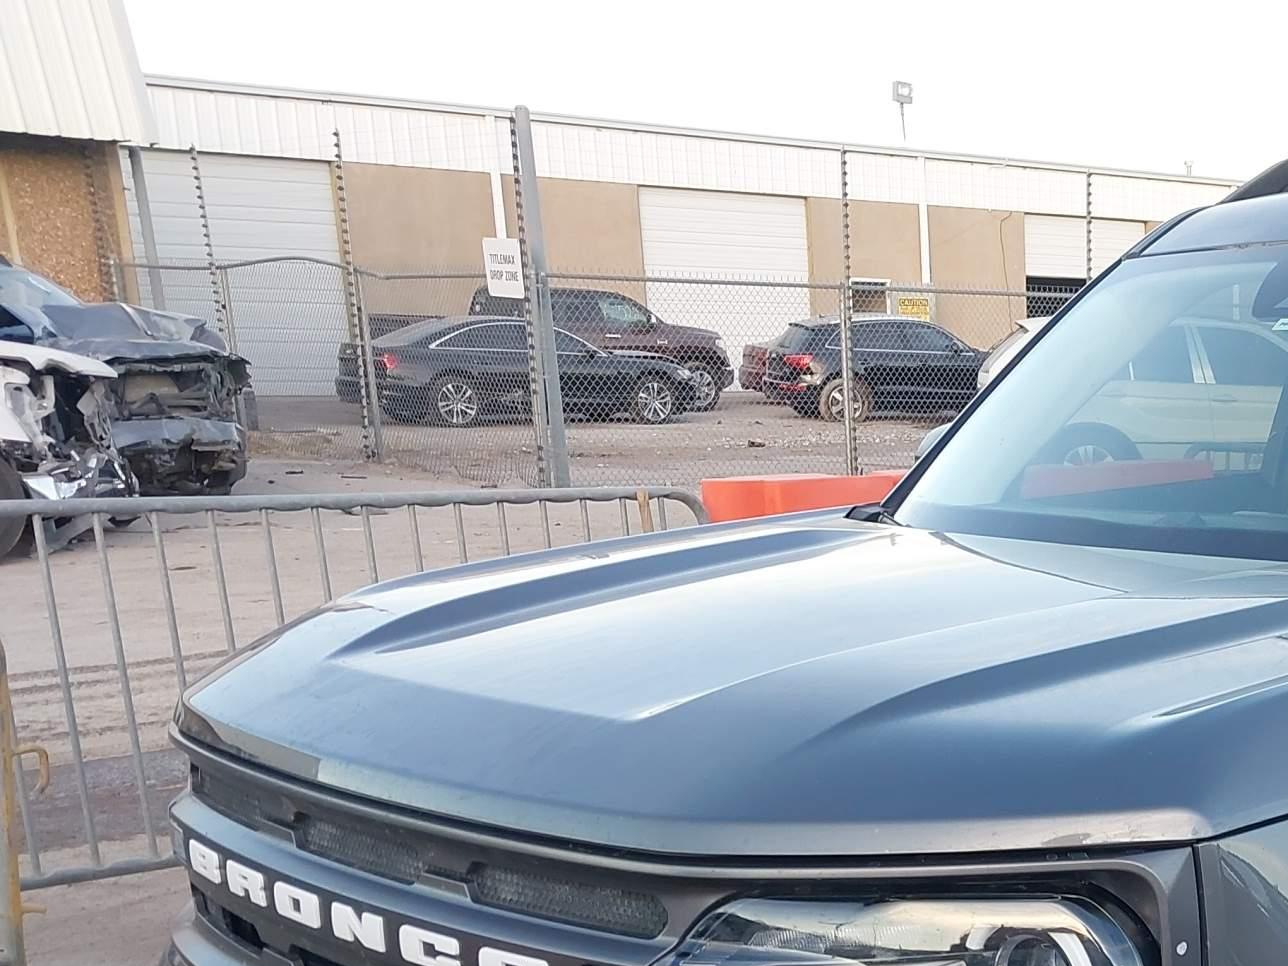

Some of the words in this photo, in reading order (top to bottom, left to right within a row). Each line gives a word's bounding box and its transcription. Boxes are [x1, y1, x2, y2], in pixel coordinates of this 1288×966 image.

[489, 254, 515, 265] TITLEMAX
[490, 270, 503, 280] DROP
[505, 271, 519, 281] ZONE
